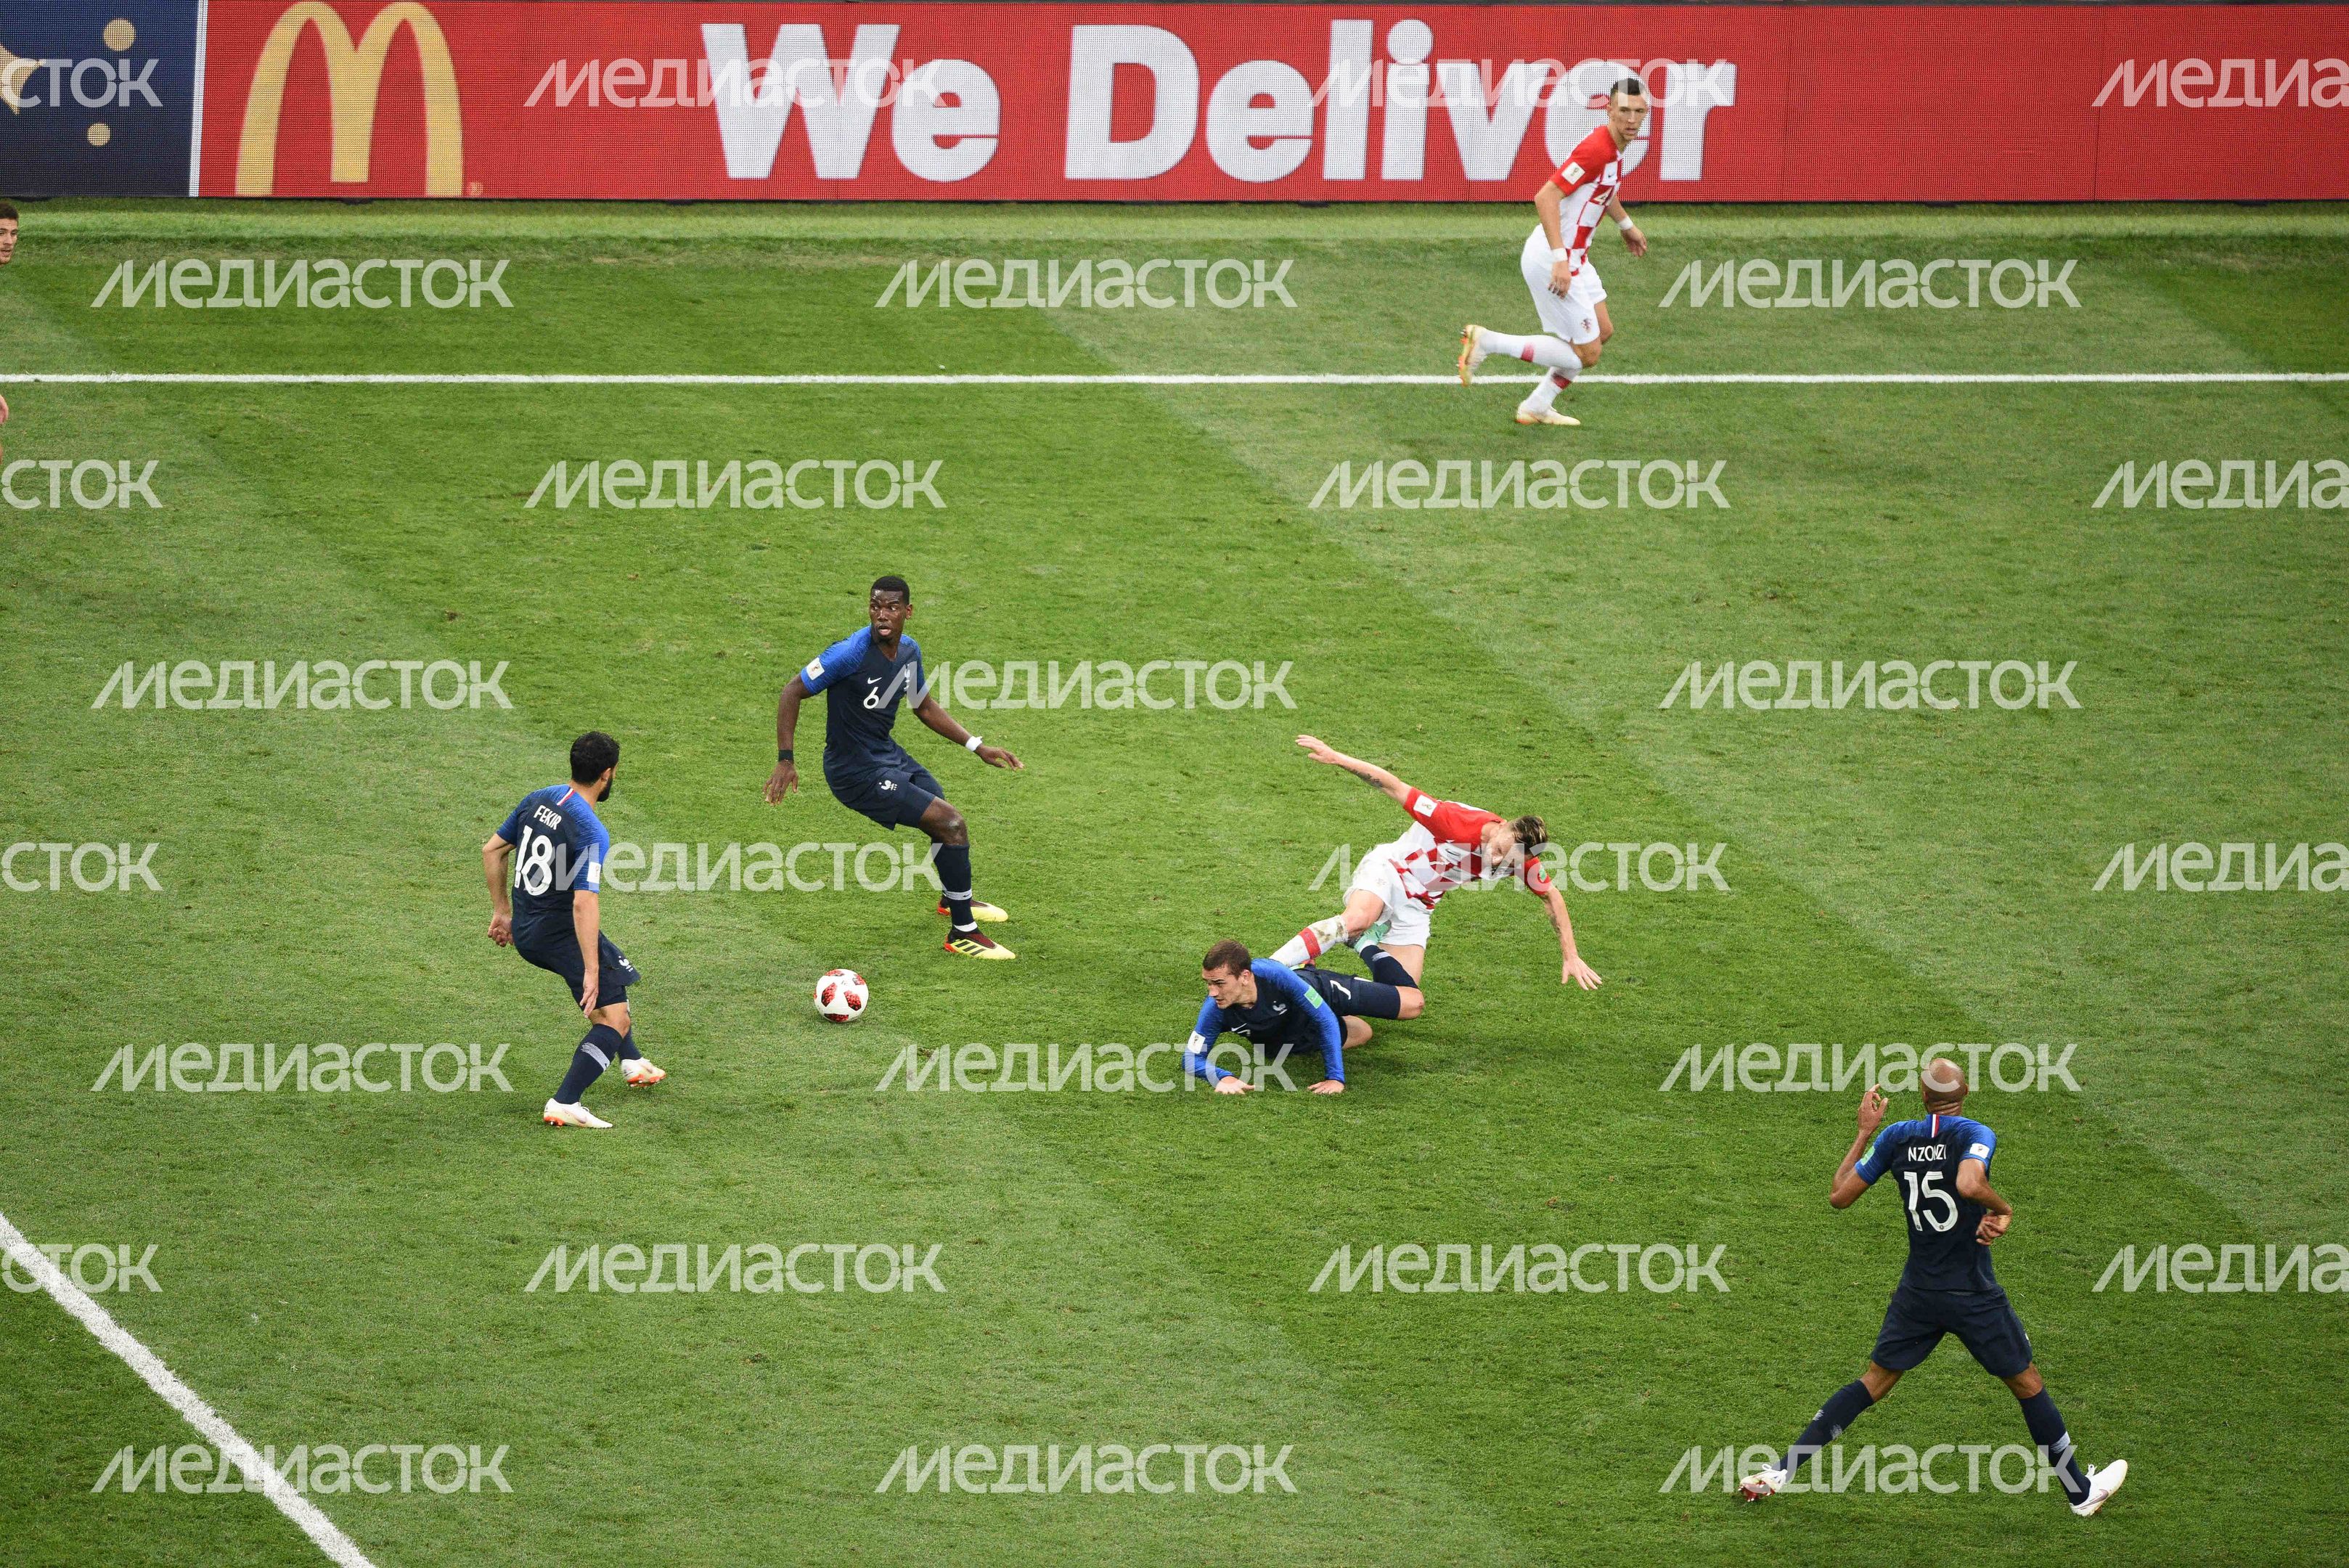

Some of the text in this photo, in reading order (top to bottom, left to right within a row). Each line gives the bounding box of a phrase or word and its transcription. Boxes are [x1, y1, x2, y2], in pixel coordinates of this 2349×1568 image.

[702, 19, 1737, 183] We Deliver
[863, 686, 880, 709] 6
[533, 804, 562, 830] FEKIR
[514, 825, 553, 897] 18
[1329, 979, 1352, 1000] 7
[1903, 1171, 1958, 1233] 15
